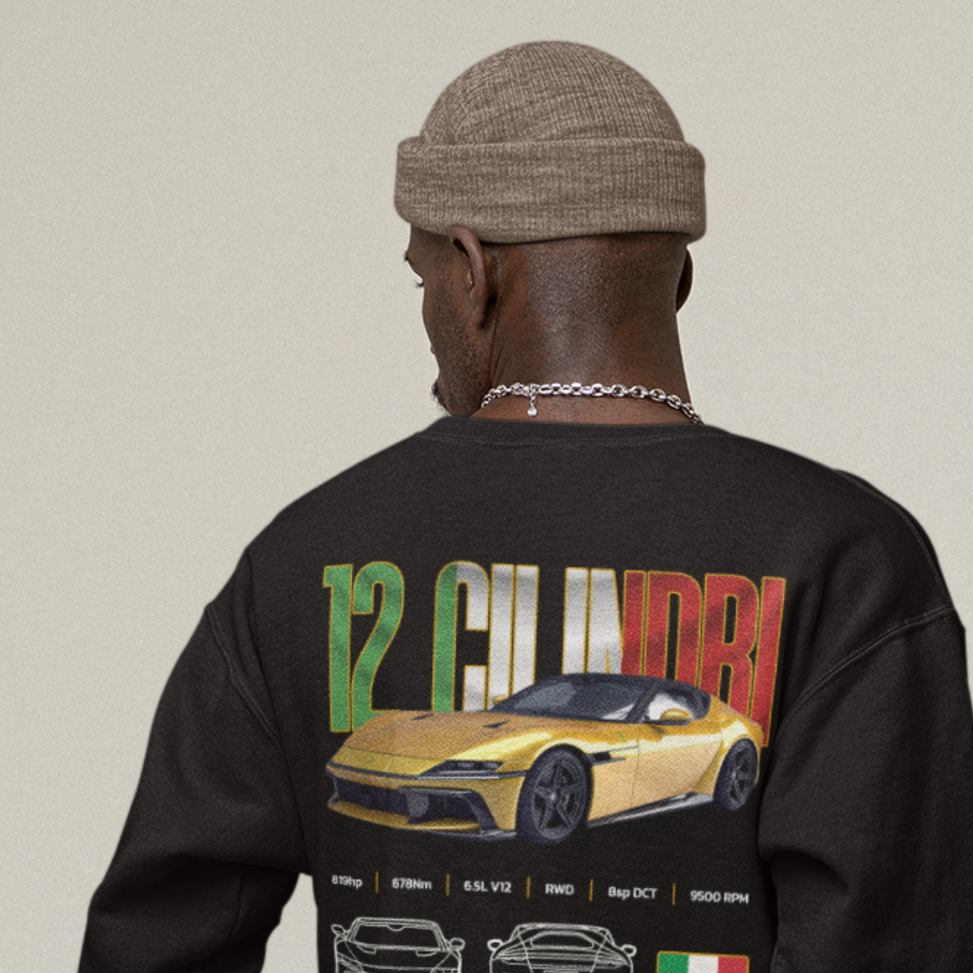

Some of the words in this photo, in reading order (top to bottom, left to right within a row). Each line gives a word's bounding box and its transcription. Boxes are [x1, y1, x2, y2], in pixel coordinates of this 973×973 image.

[323, 561, 405, 732] 12
[392, 877, 432, 890] 678Nm
[491, 881, 512, 893] V12
[545, 883, 575, 895] RWD
[633, 887, 658, 899] DCT
[690, 890, 721, 903] 9500
[724, 892, 750, 904] RPM
